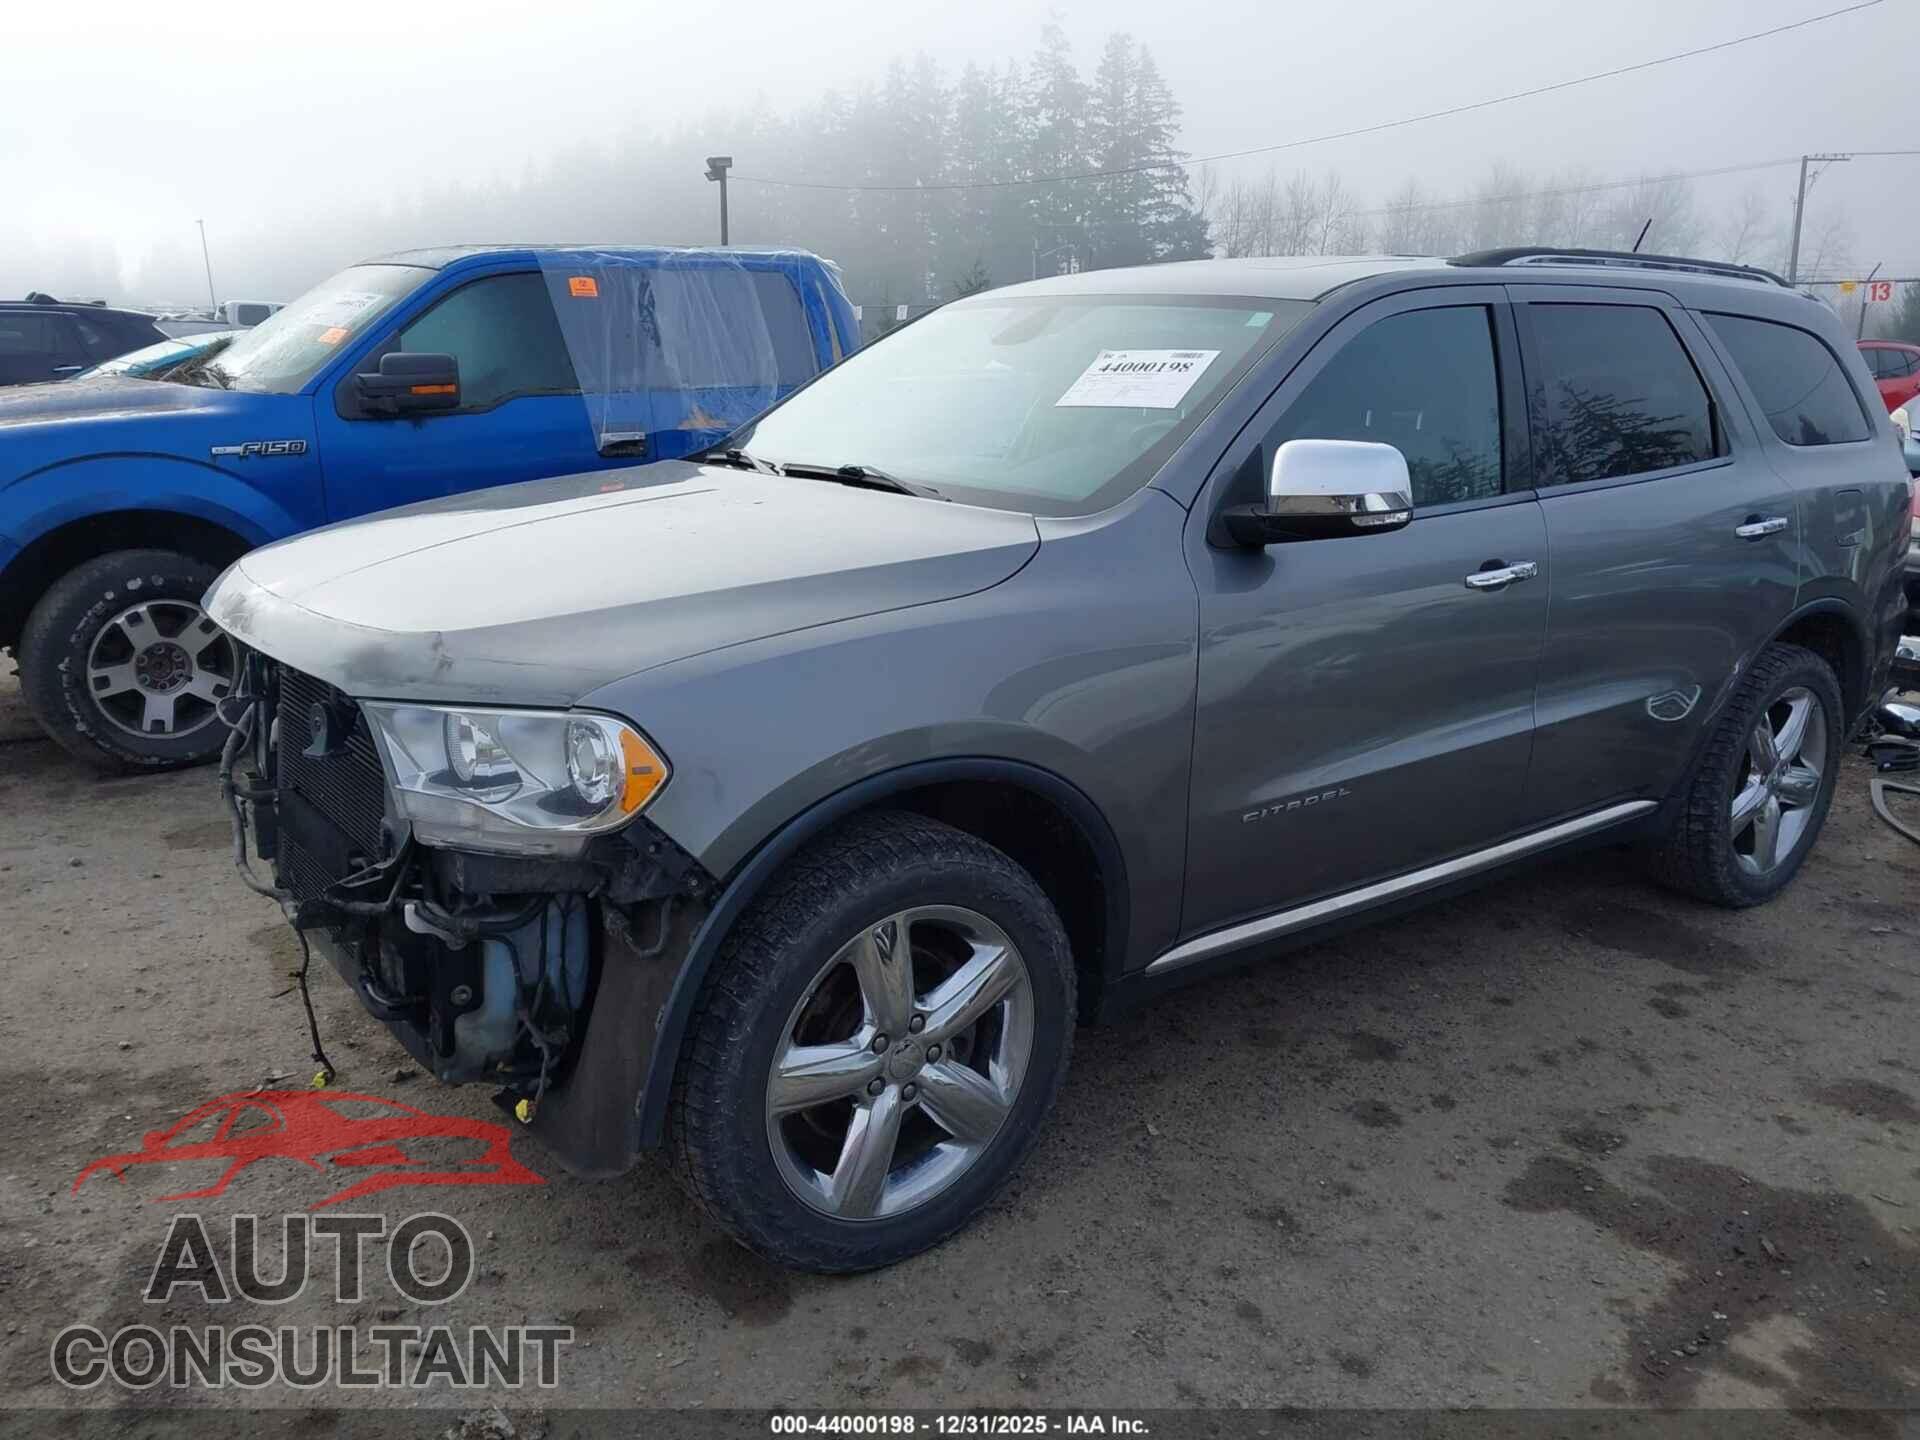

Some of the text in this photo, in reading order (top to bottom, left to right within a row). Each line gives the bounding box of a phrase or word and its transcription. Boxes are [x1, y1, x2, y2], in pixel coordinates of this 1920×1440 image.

[1871, 283, 1891, 302] 13
[1098, 361, 1194, 374] 44000198
[240, 439, 306, 456] F150
